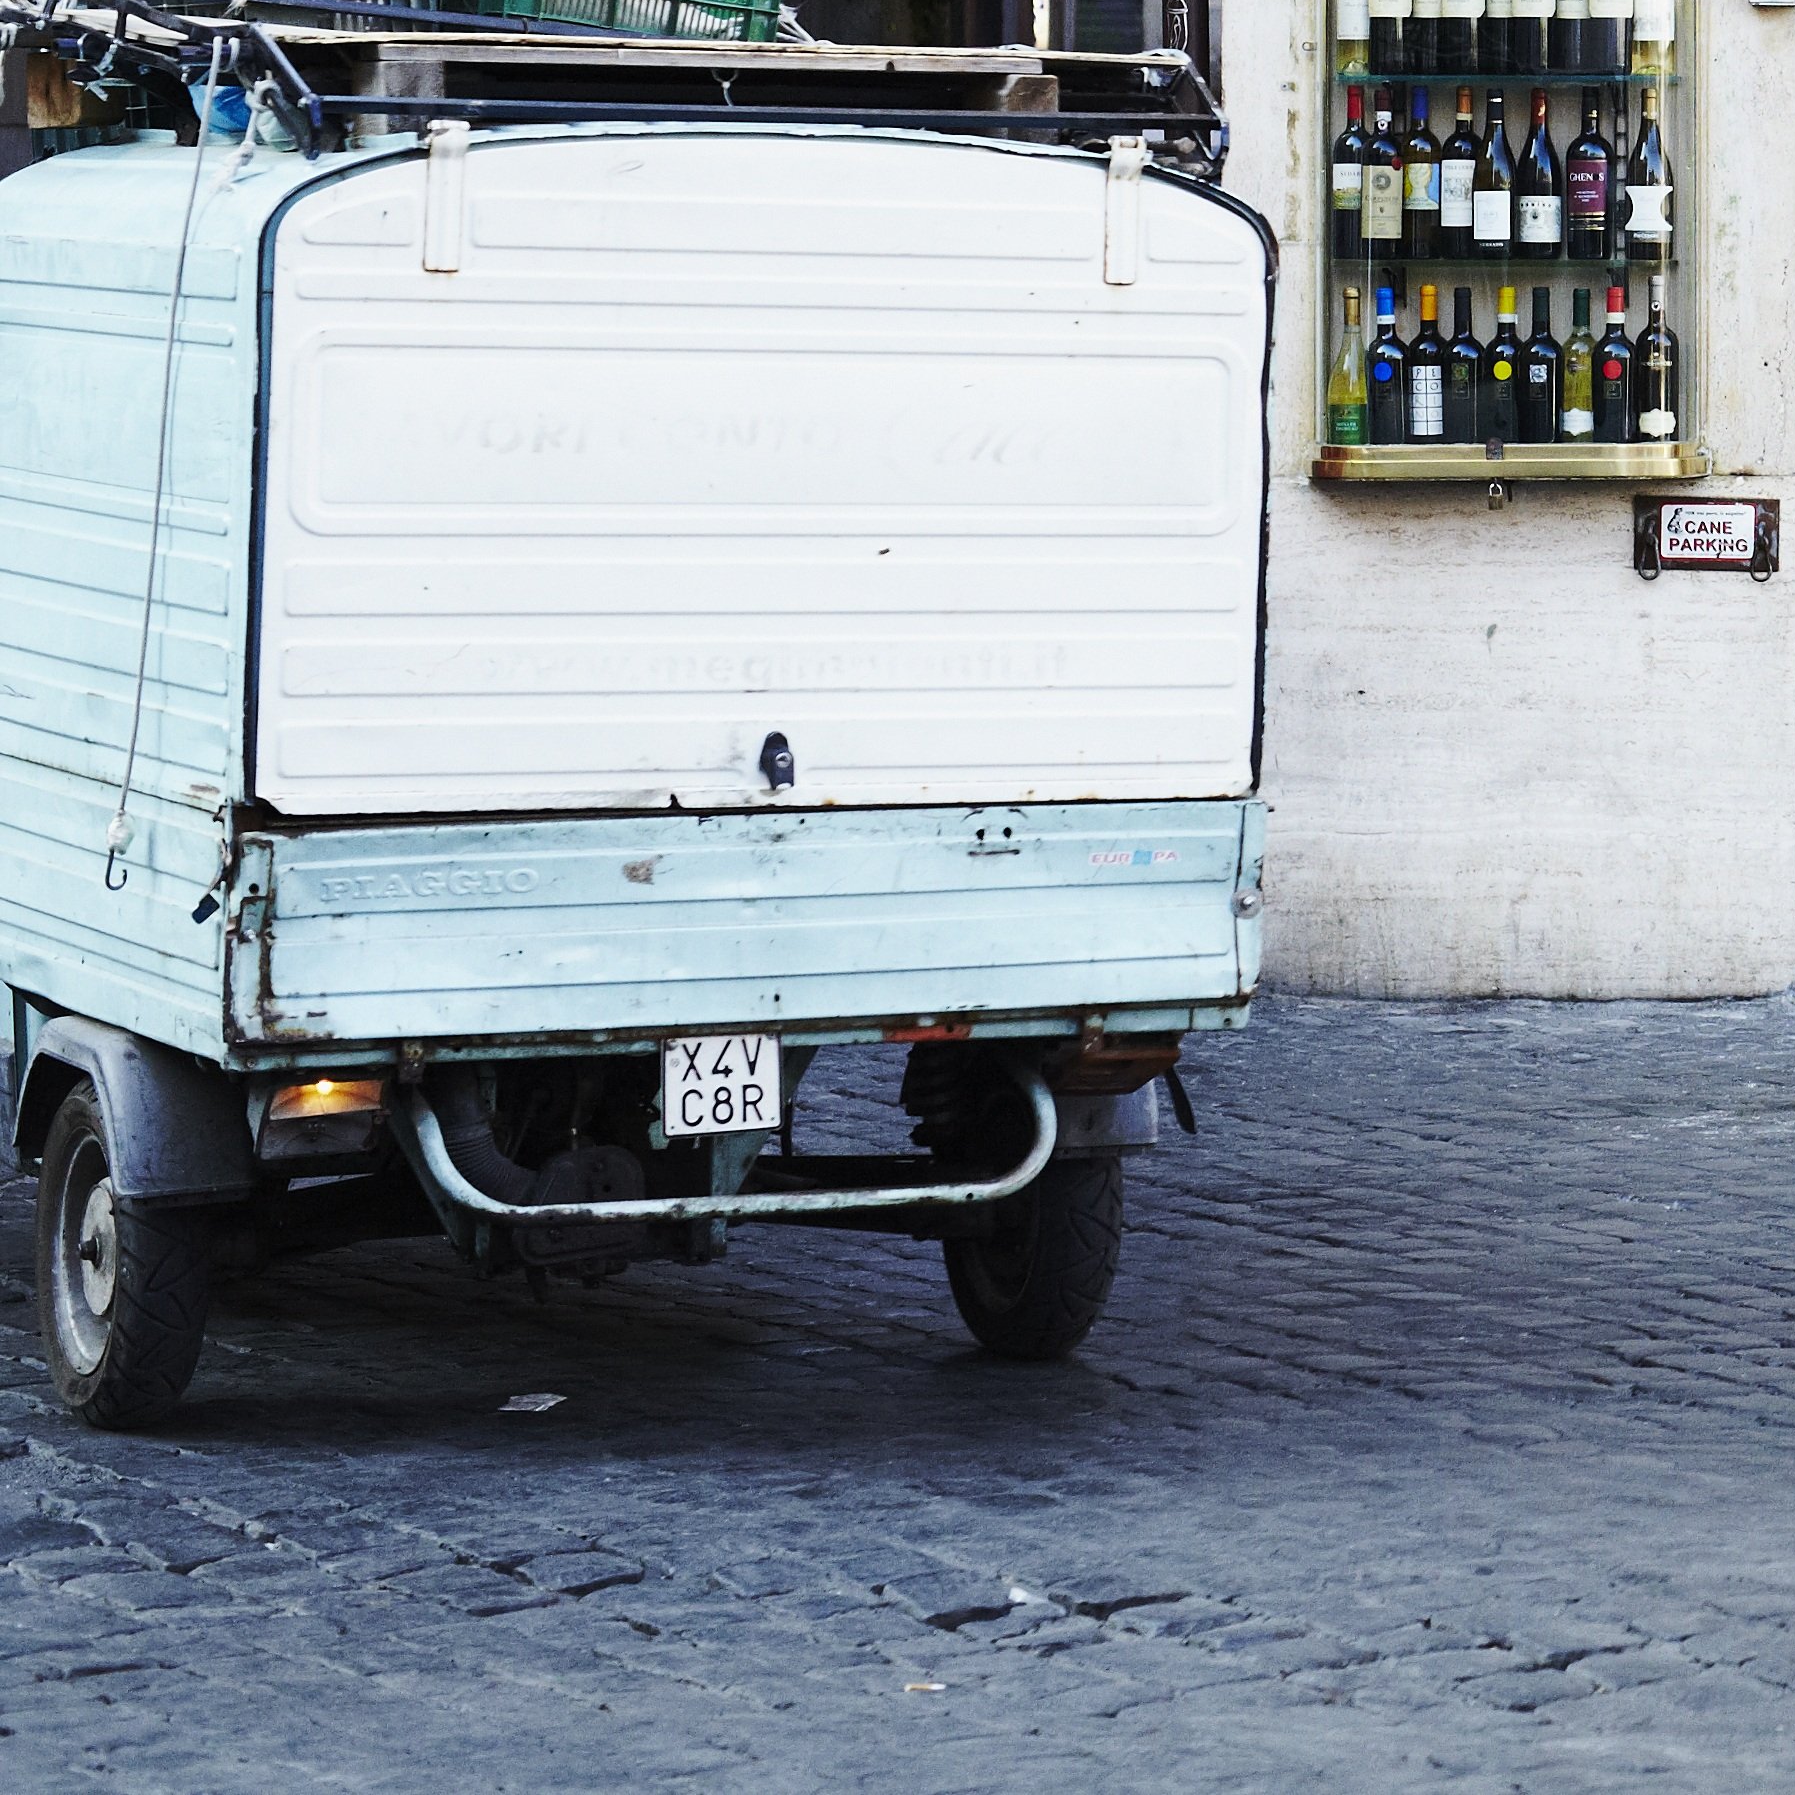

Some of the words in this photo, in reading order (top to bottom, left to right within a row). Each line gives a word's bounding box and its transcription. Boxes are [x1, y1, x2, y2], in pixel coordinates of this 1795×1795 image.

[1569, 172, 1605, 182] GHENS
[1685, 520, 1732, 534] CANE
[1669, 537, 1748, 552] PARKING
[320, 867, 540, 903] PIAGGIO
[681, 1037, 763, 1082] X4V
[681, 1083, 764, 1127] C8R
